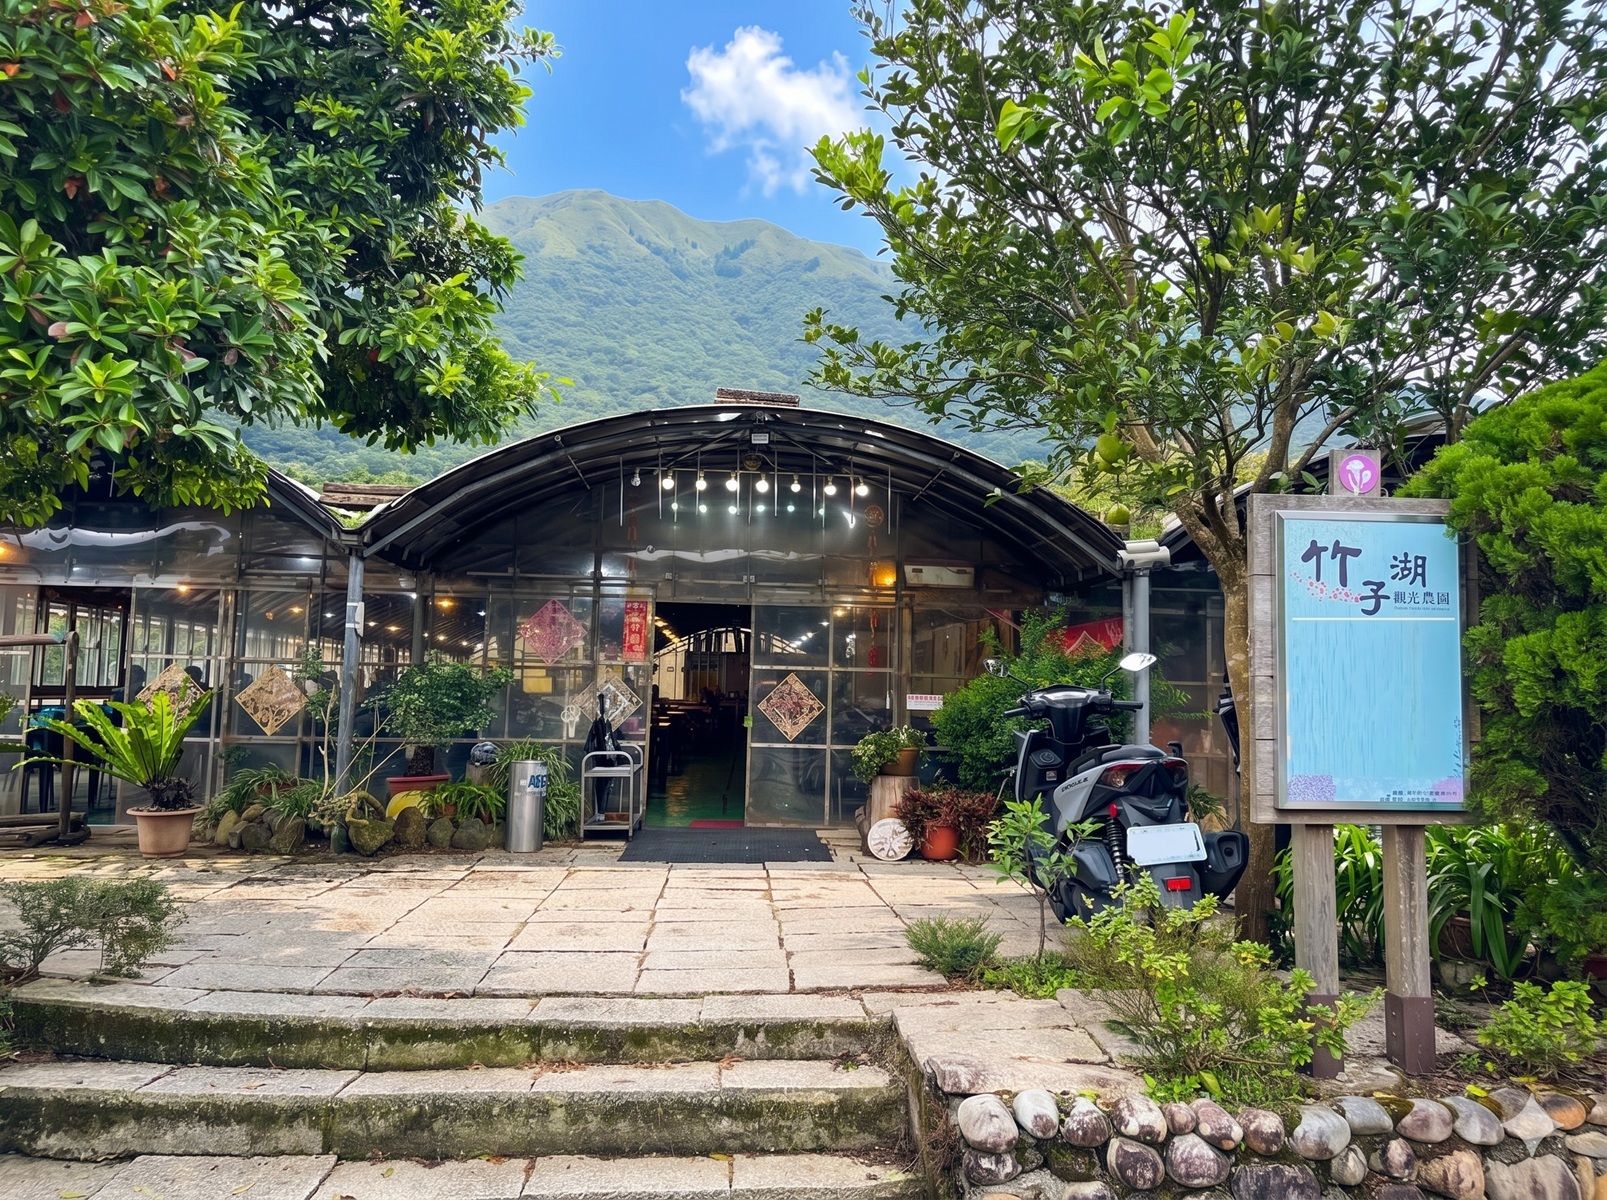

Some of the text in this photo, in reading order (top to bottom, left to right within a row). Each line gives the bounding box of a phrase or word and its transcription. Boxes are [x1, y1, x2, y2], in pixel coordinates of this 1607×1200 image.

[1301, 539, 1427, 616] 竹子湖
[1393, 591, 1450, 605] 觀光農園
